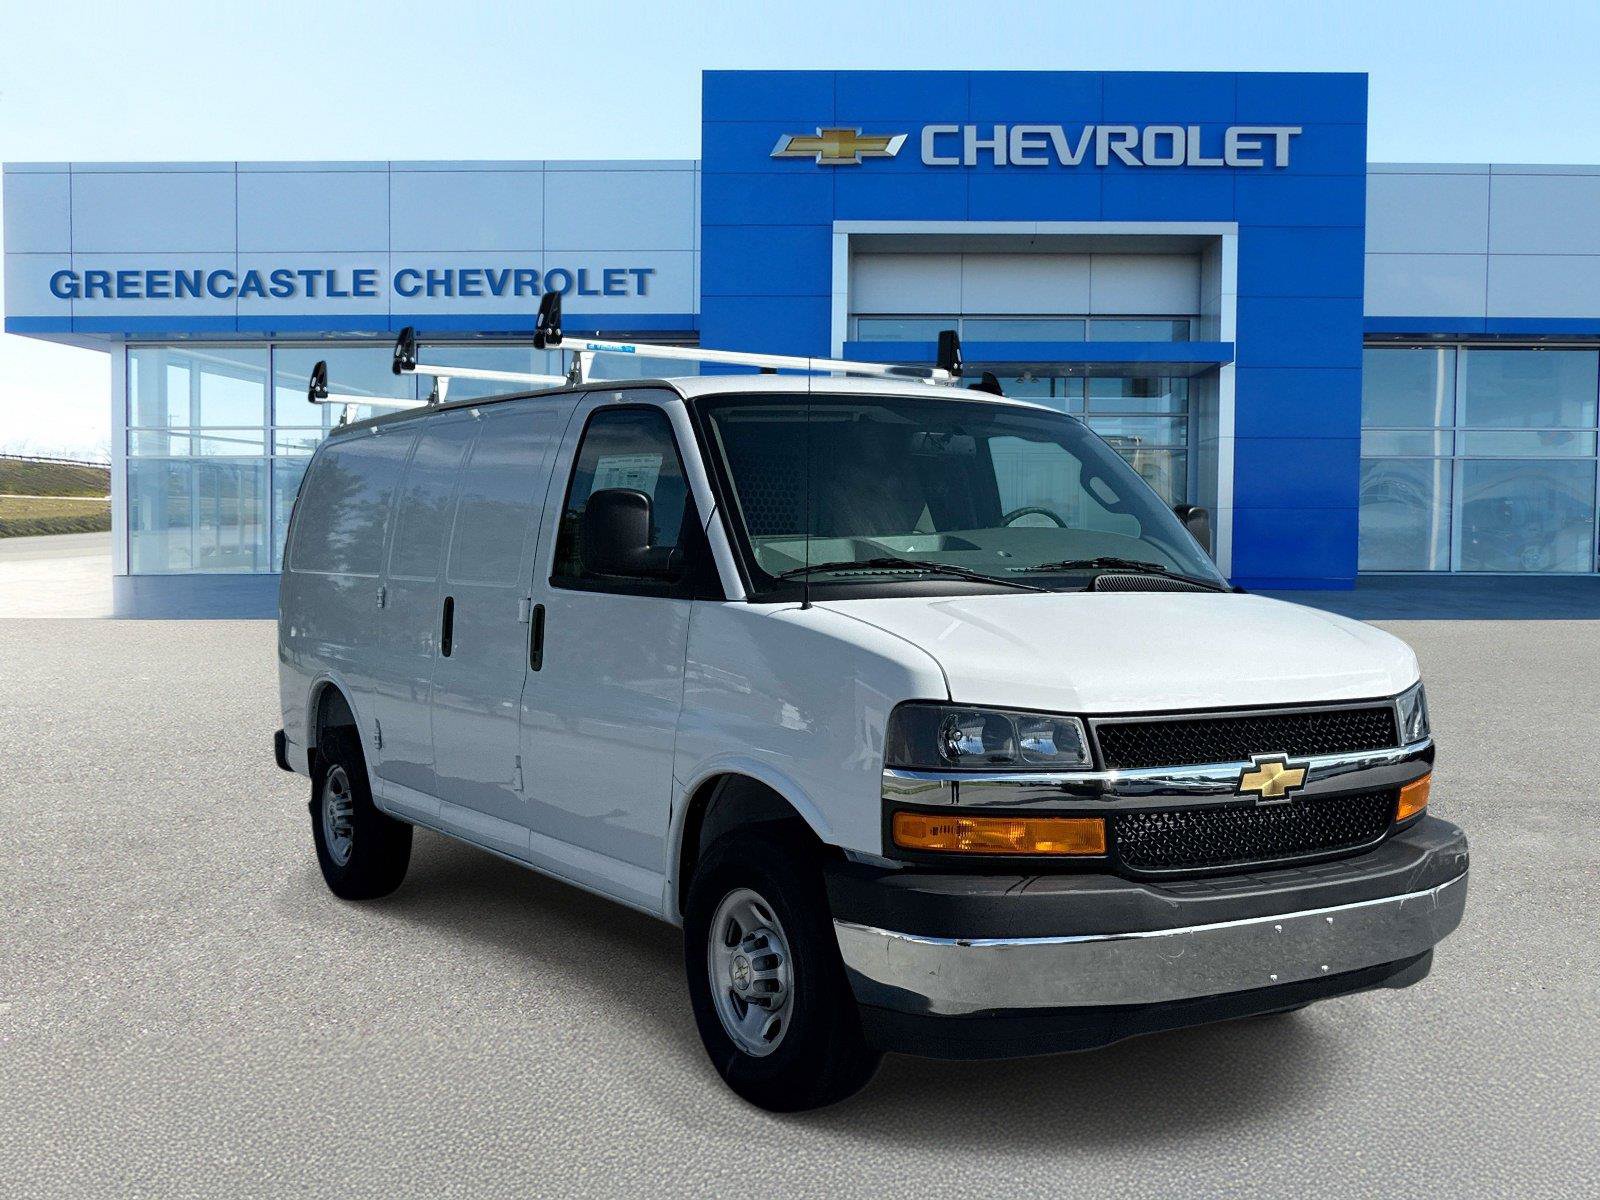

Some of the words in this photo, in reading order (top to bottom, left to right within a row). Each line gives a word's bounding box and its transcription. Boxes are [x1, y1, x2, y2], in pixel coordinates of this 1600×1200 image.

[921, 125, 1302, 167] CHEVROLET
[50, 269, 378, 298] GREENCASTLE
[393, 268, 655, 297] CHEVROLET
